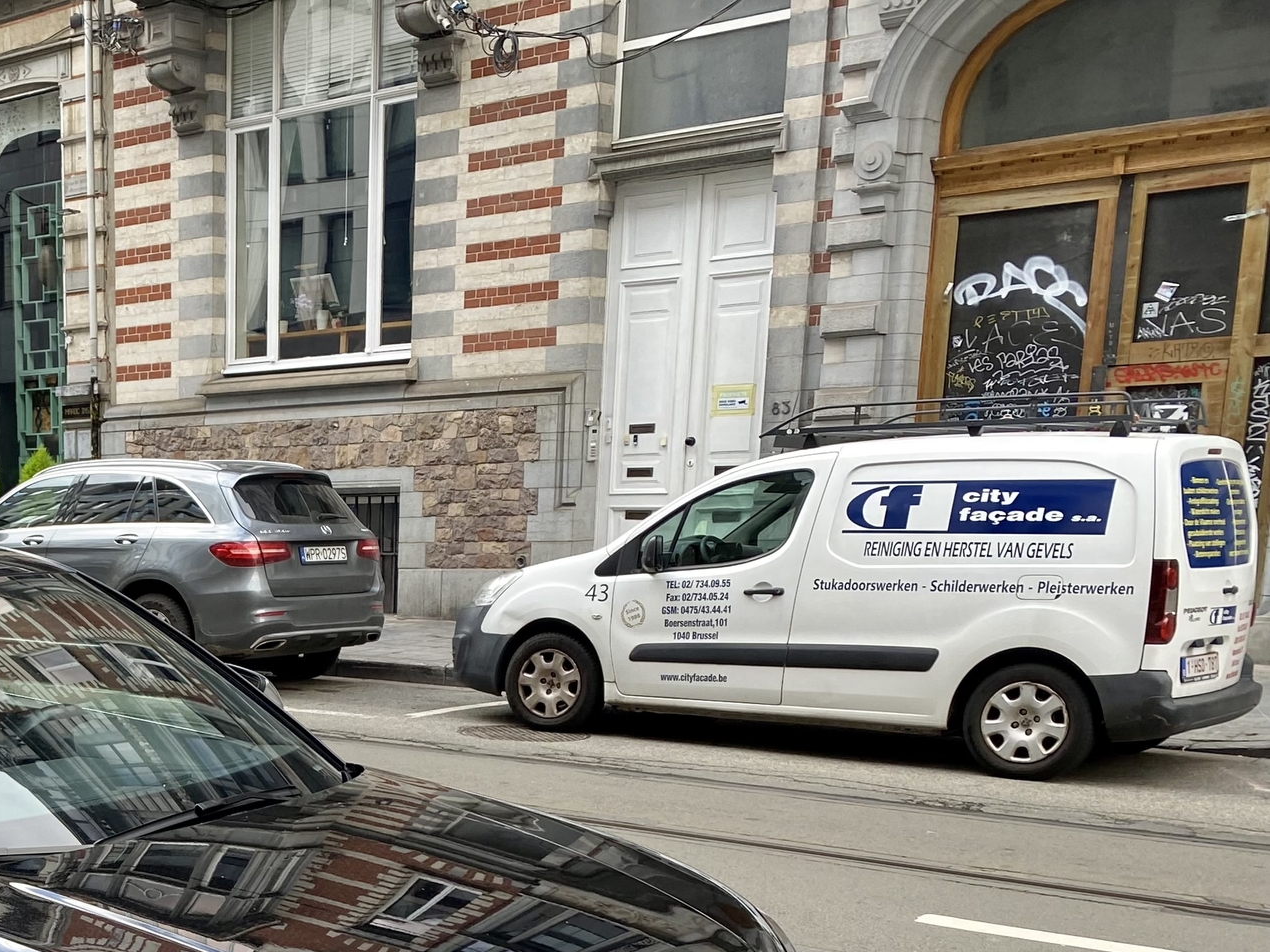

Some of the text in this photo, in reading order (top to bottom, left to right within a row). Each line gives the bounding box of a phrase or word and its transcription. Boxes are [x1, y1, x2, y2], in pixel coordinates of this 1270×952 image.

[771, 400, 791, 415] 83
[962, 488, 1020, 506] city
[959, 507, 1102, 526] façade s.a.
[863, 541, 1074, 559] REINIGING EN HERSTEL VAN GEVELS
[666, 579, 731, 589] TEL: 02/ 734.09.55
[813, 578, 919, 592] Stukadoorswerken
[930, 579, 1025, 594] Schilderwerken
[1037, 580, 1135, 596] Pleisterwerken
[584, 584, 609, 602] 43
[666, 592, 729, 602] Fax: 02/734.05.24
[661, 605, 731, 615] GSM: 0475/43.44.41
[664, 618, 728, 629] Boersenstraat,101
[673, 631, 719, 640] 1040 Brussel
[660, 673, 728, 684] www.cityfacade.be
